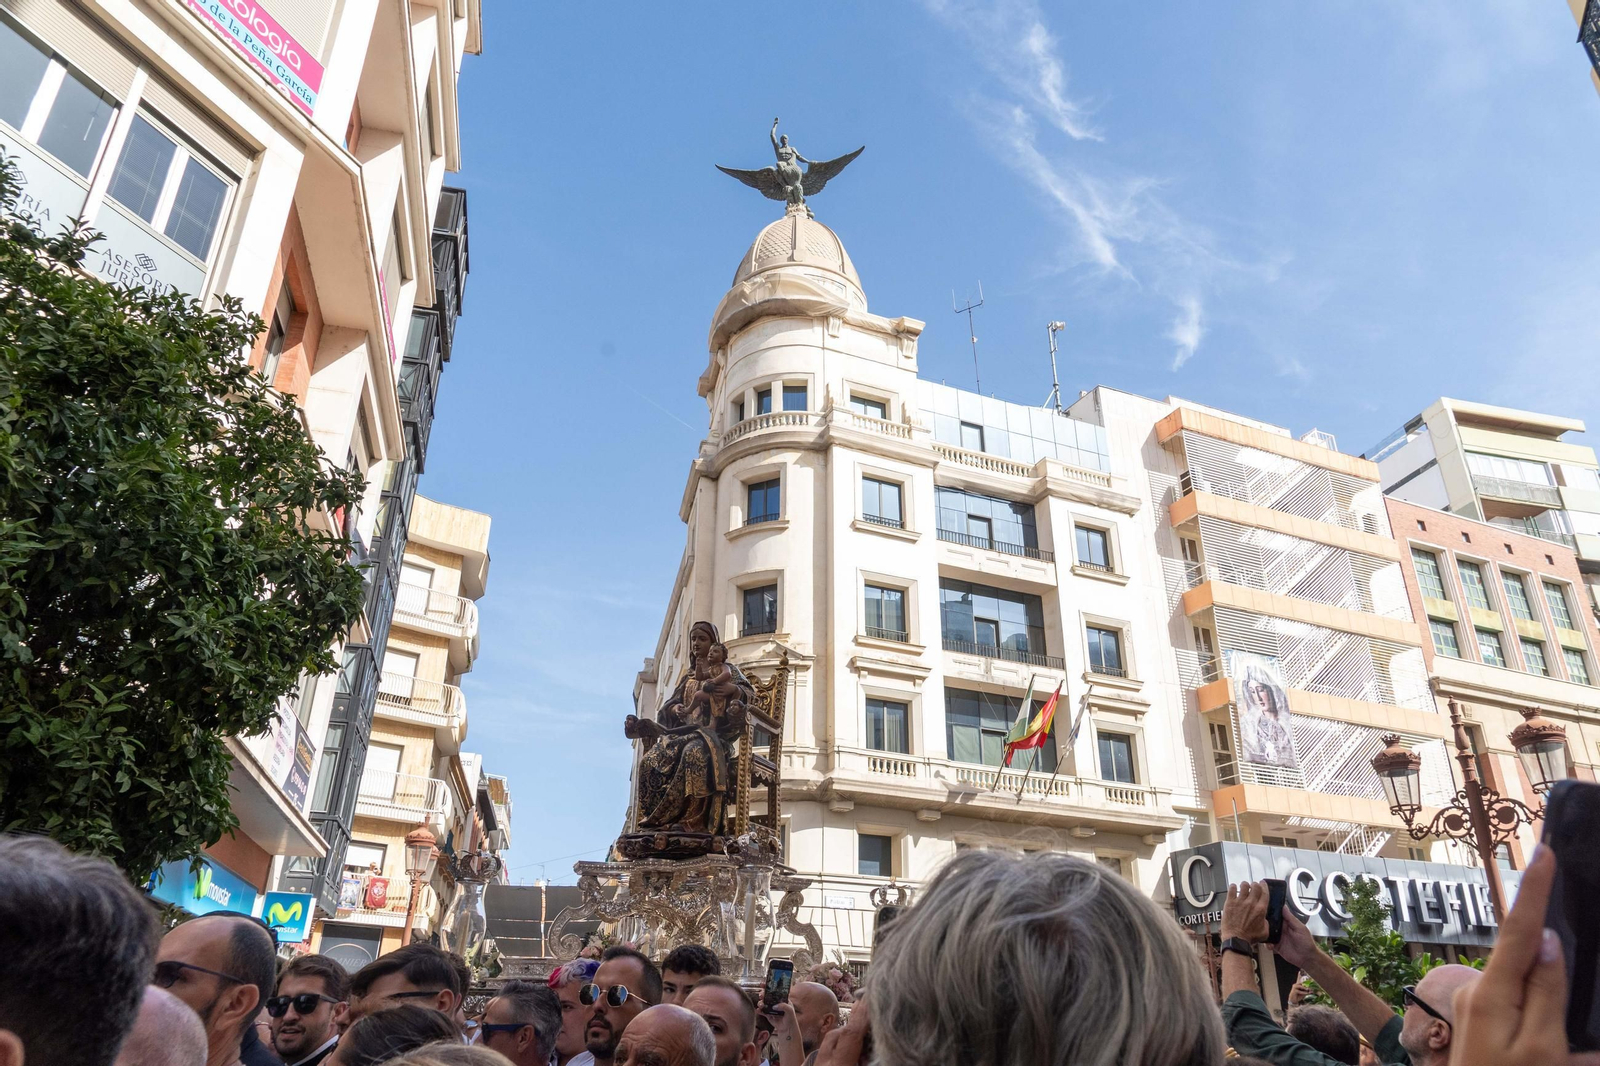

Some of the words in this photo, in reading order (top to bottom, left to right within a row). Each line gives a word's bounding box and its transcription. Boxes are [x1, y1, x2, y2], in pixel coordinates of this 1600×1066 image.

[209, 4, 226, 22] de
[228, 18, 239, 36] la
[243, 32, 273, 67] Peña
[275, 65, 313, 104] García
[102, 248, 169, 296] ASESORÍ
[206, 881, 231, 907] movistar
[1181, 855, 1215, 908] C
[1286, 867, 1499, 936] CORTEFIE
[270, 925, 299, 934] ovistar
[1178, 910, 1223, 926] CORTEFIE
